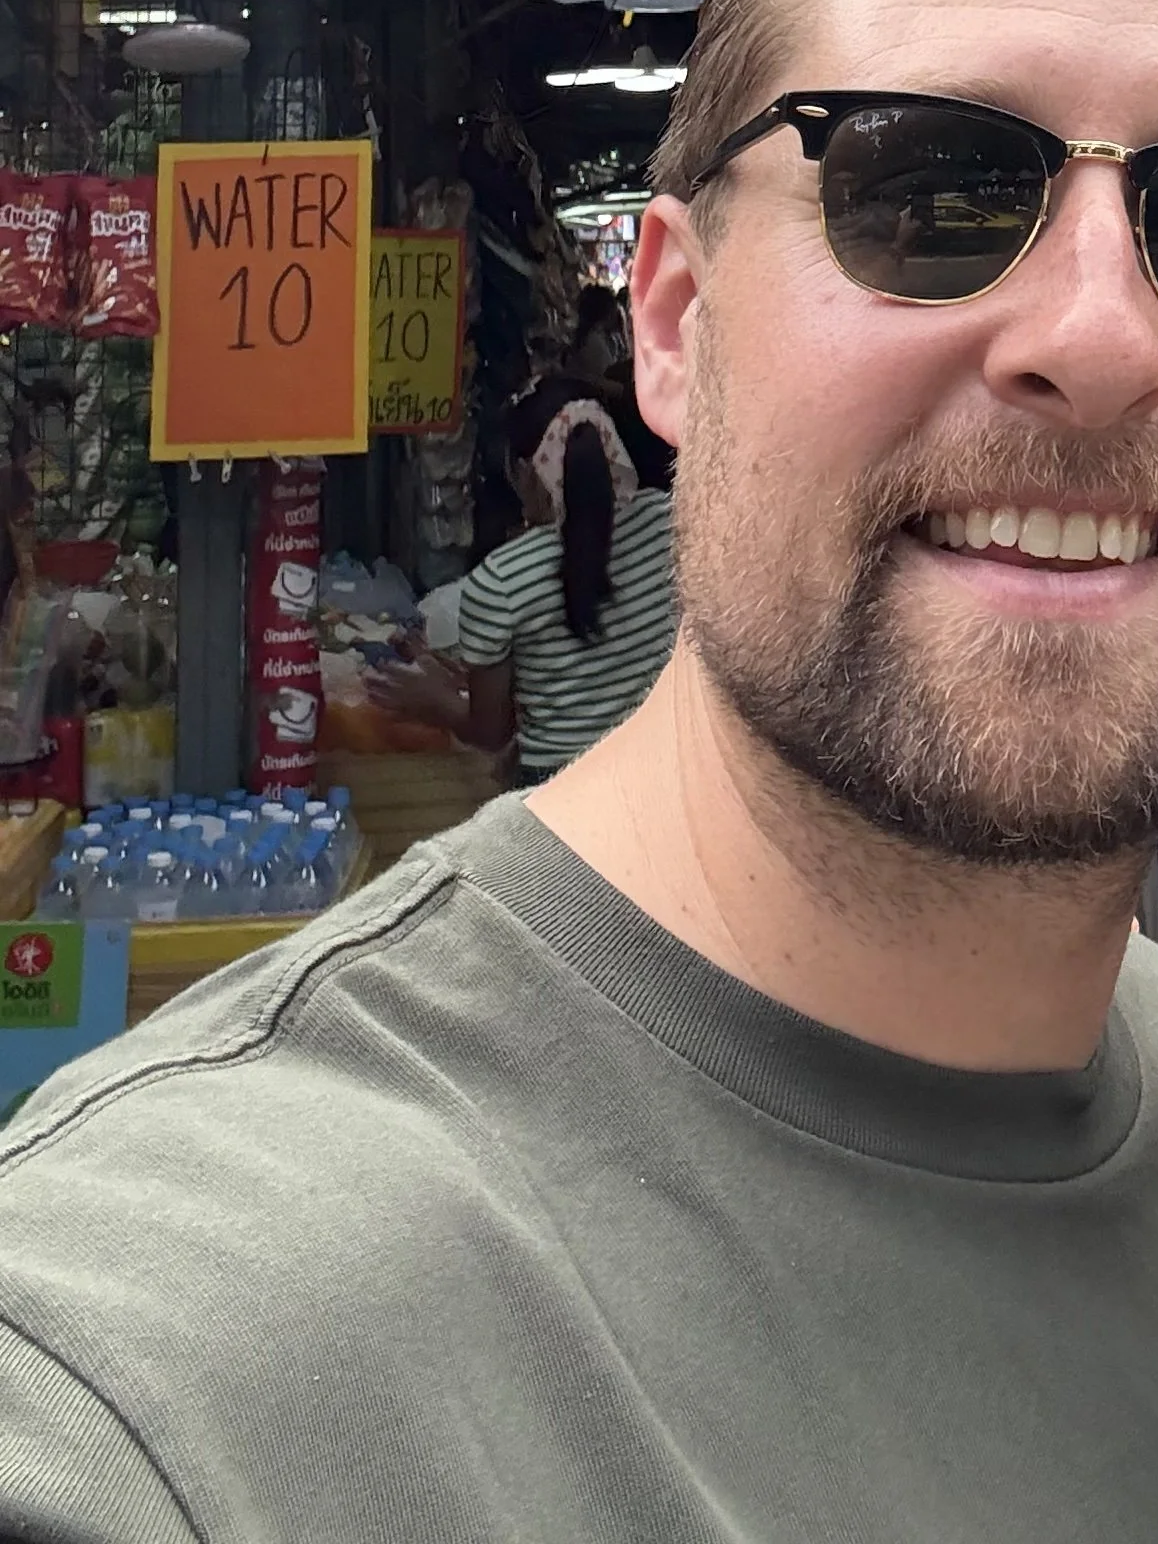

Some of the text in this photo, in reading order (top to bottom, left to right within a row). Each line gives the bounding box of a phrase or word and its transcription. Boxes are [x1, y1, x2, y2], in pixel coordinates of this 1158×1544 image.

[178, 172, 353, 252] WATER
[371, 251, 453, 301] ATER
[218, 261, 313, 351] 10
[375, 309, 430, 363] 10
[426, 395, 453, 424] 10
